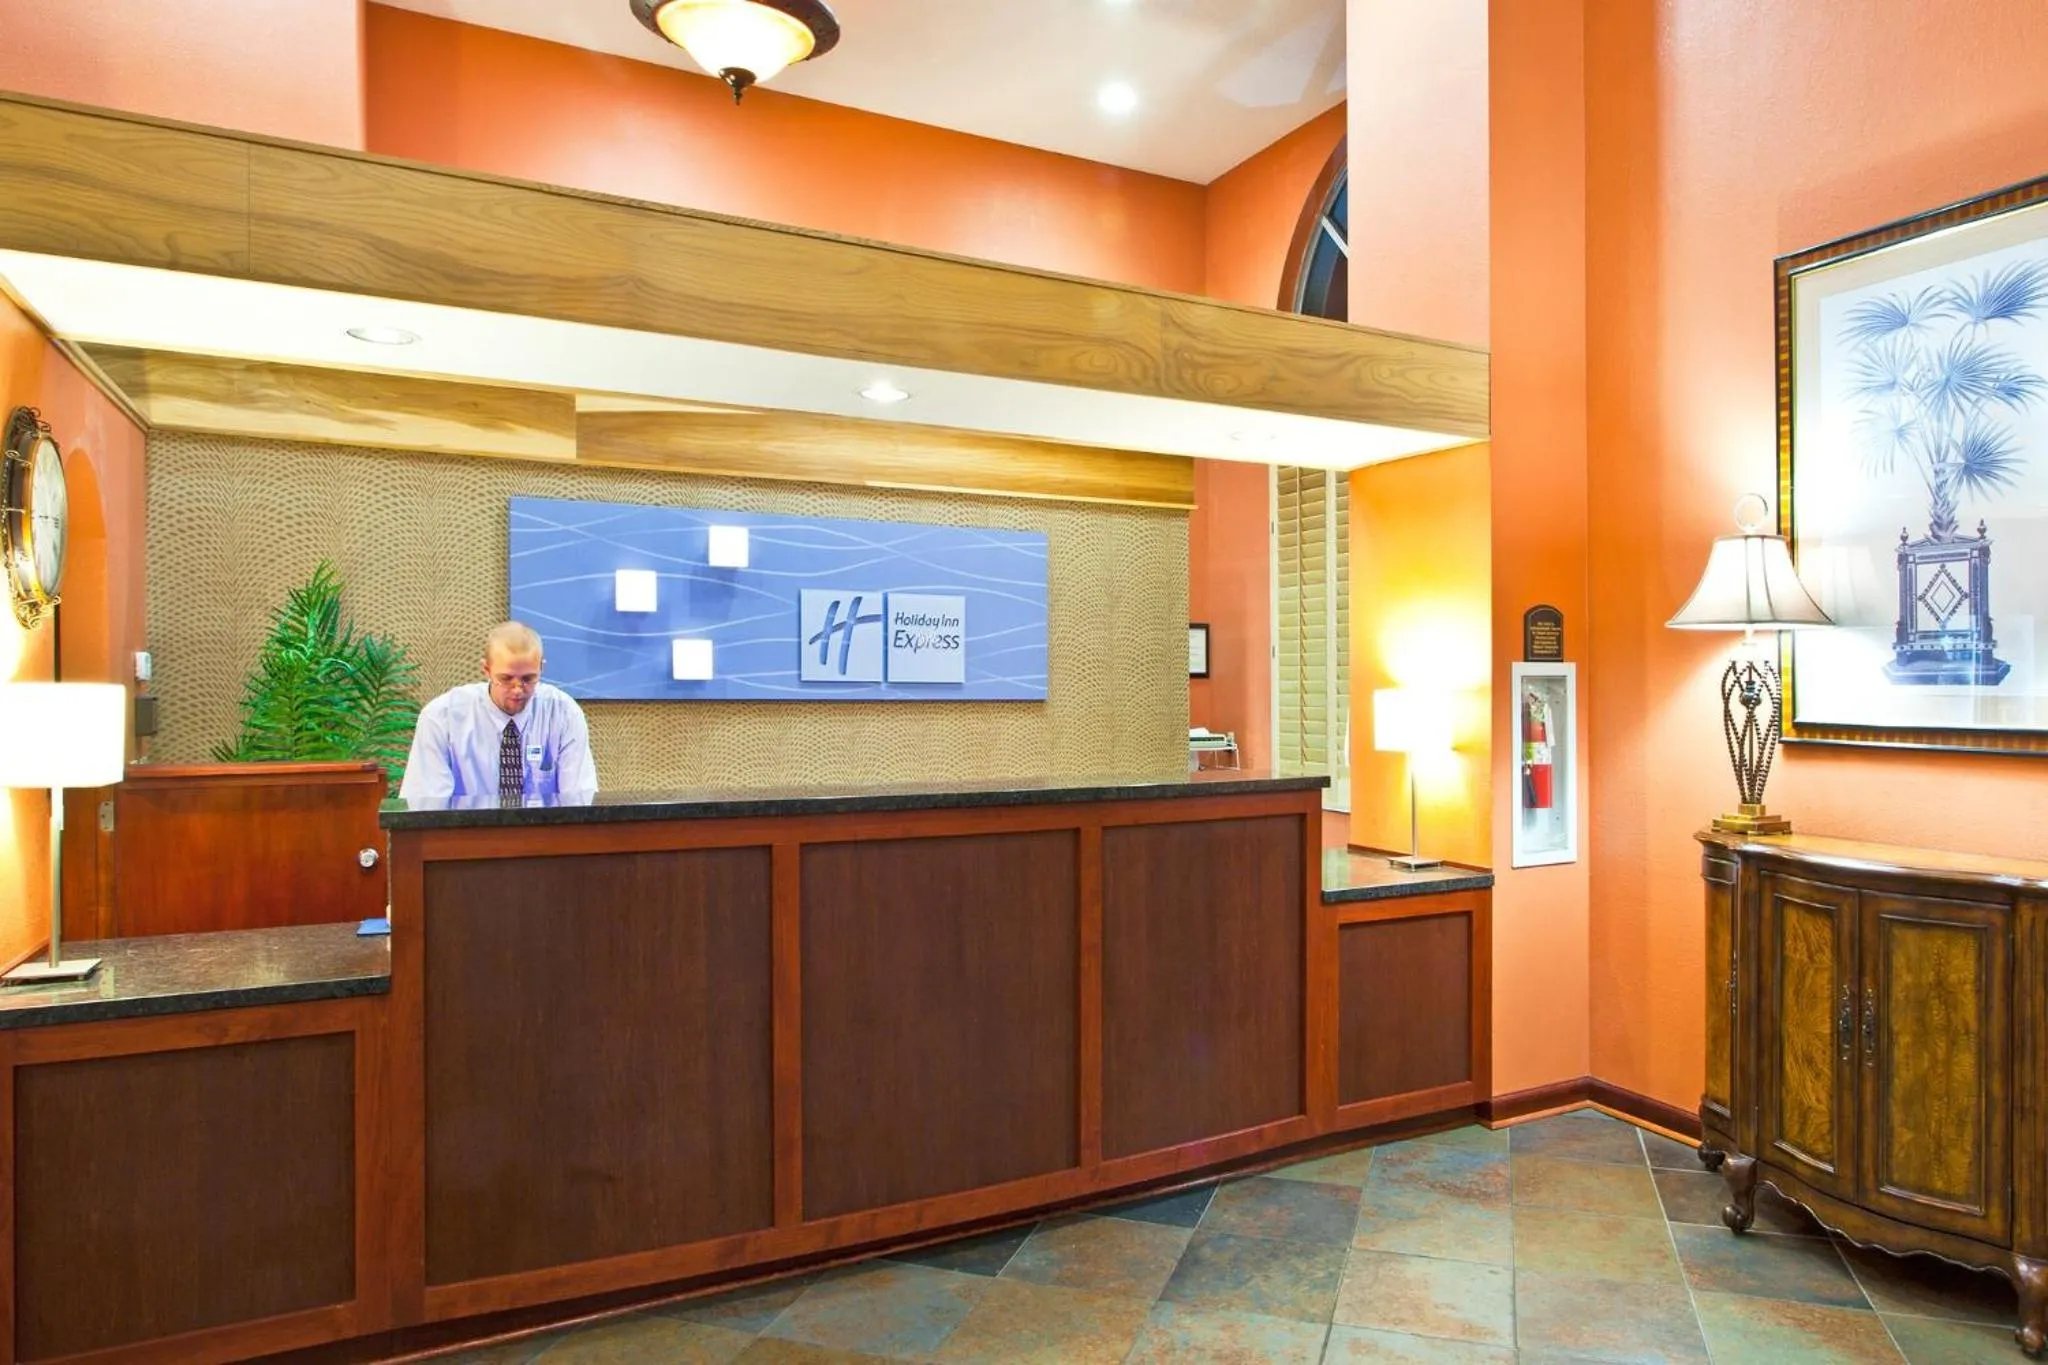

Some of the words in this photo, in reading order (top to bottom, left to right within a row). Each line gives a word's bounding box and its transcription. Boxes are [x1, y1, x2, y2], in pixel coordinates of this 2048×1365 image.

[894, 612, 940, 629] Holiday
[941, 614, 960, 628] Inn
[893, 630, 960, 654] Express
